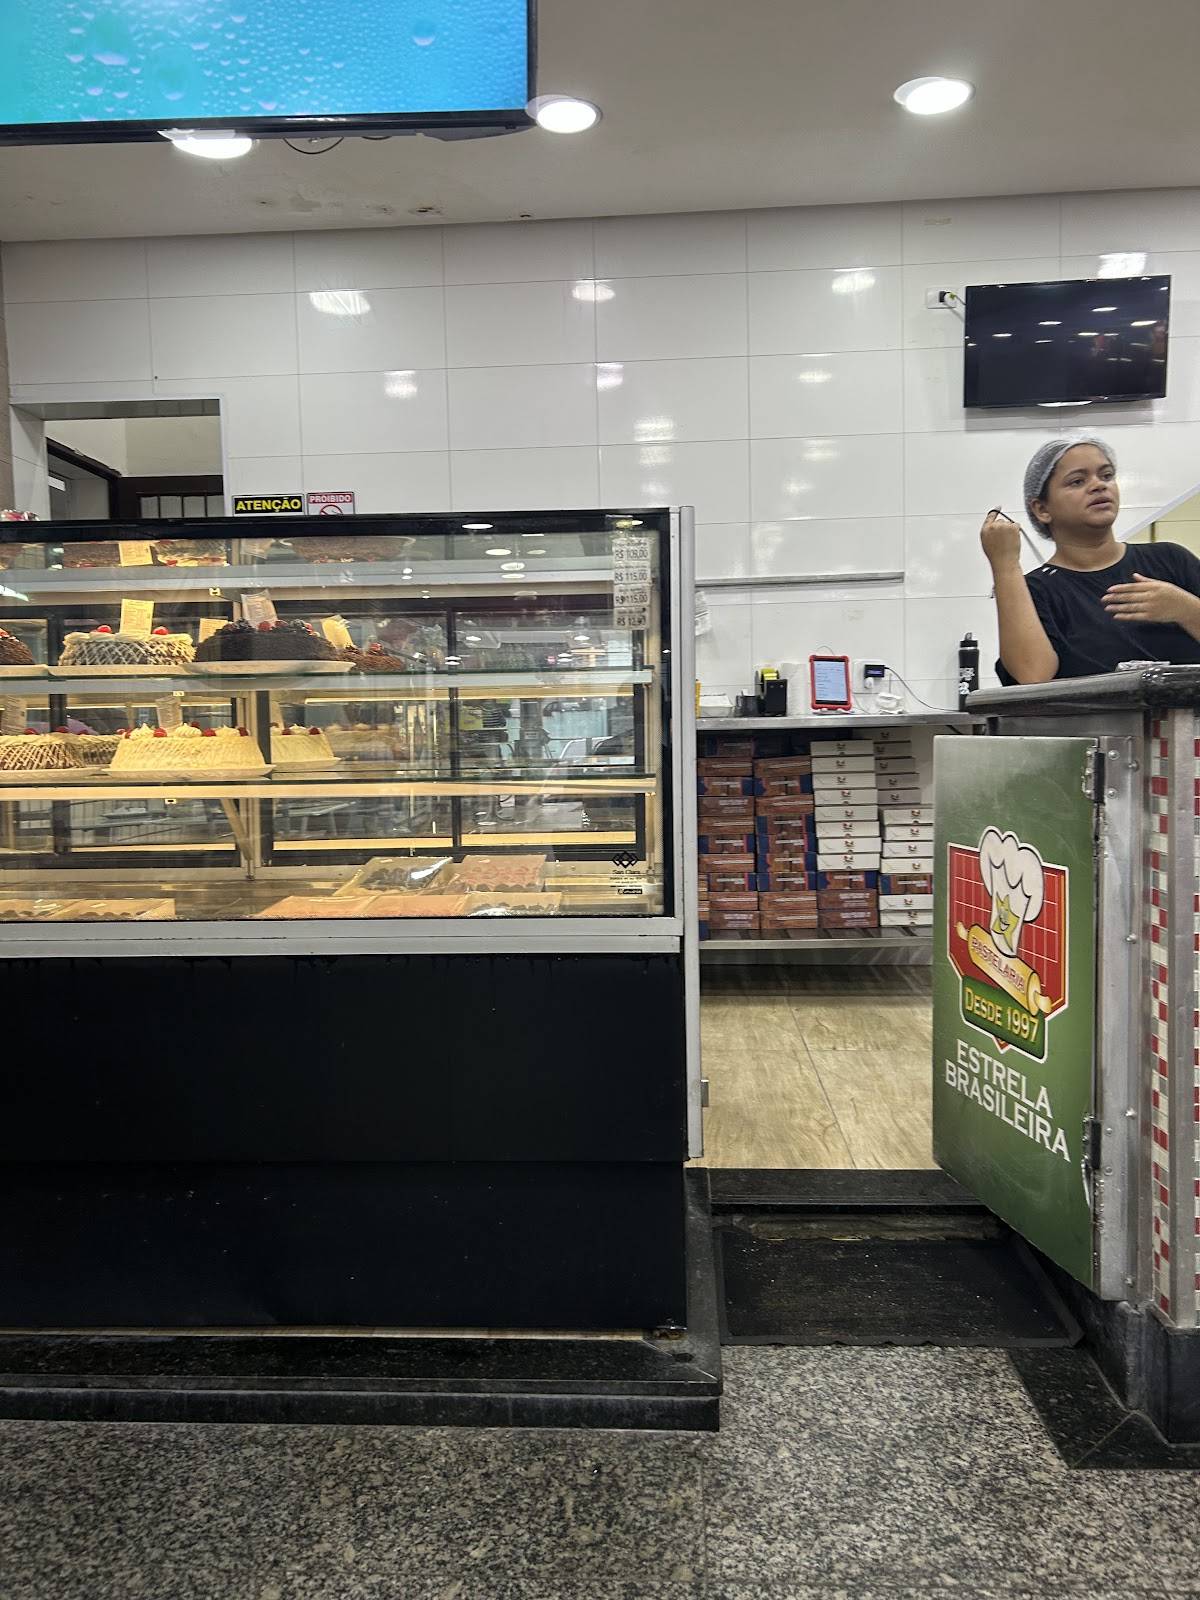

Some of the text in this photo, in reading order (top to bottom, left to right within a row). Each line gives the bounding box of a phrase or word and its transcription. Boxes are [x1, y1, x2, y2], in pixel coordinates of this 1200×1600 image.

[236, 497, 301, 512] ATENÇÃO
[309, 494, 351, 503] PROIBIDO
[971, 936, 1026, 995] PASTELARIA
[965, 987, 1040, 1044] DESDE 1997
[956, 1038, 1053, 1119] ESTRELA
[945, 1060, 1071, 1163] BRASILEIRA
